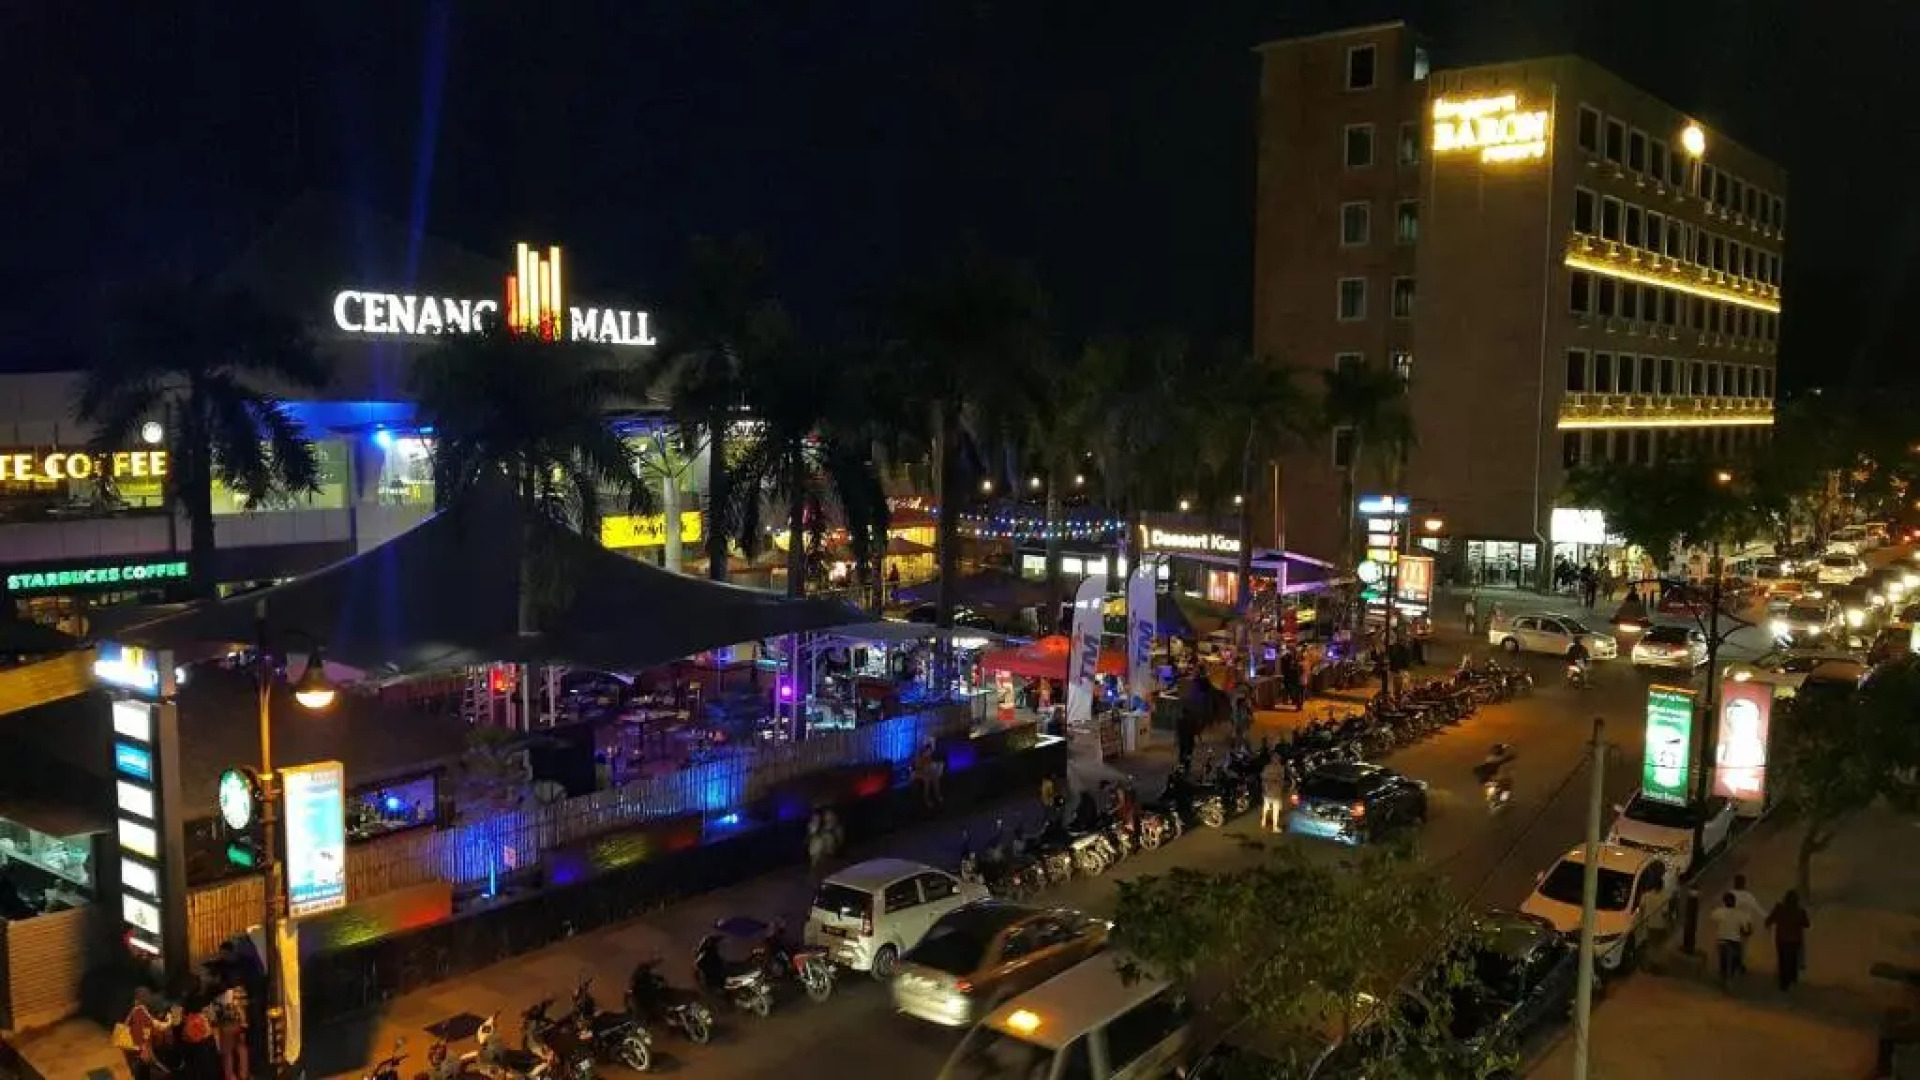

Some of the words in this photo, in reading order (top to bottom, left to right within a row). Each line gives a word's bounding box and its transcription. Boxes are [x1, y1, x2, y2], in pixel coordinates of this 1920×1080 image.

[568, 307, 657, 346] MALL
[44, 451, 166, 479] COFEE
[633, 522, 687, 537] Mayk
[7, 567, 120, 590] STARBUCKS
[122, 562, 188, 580] COFFEE
